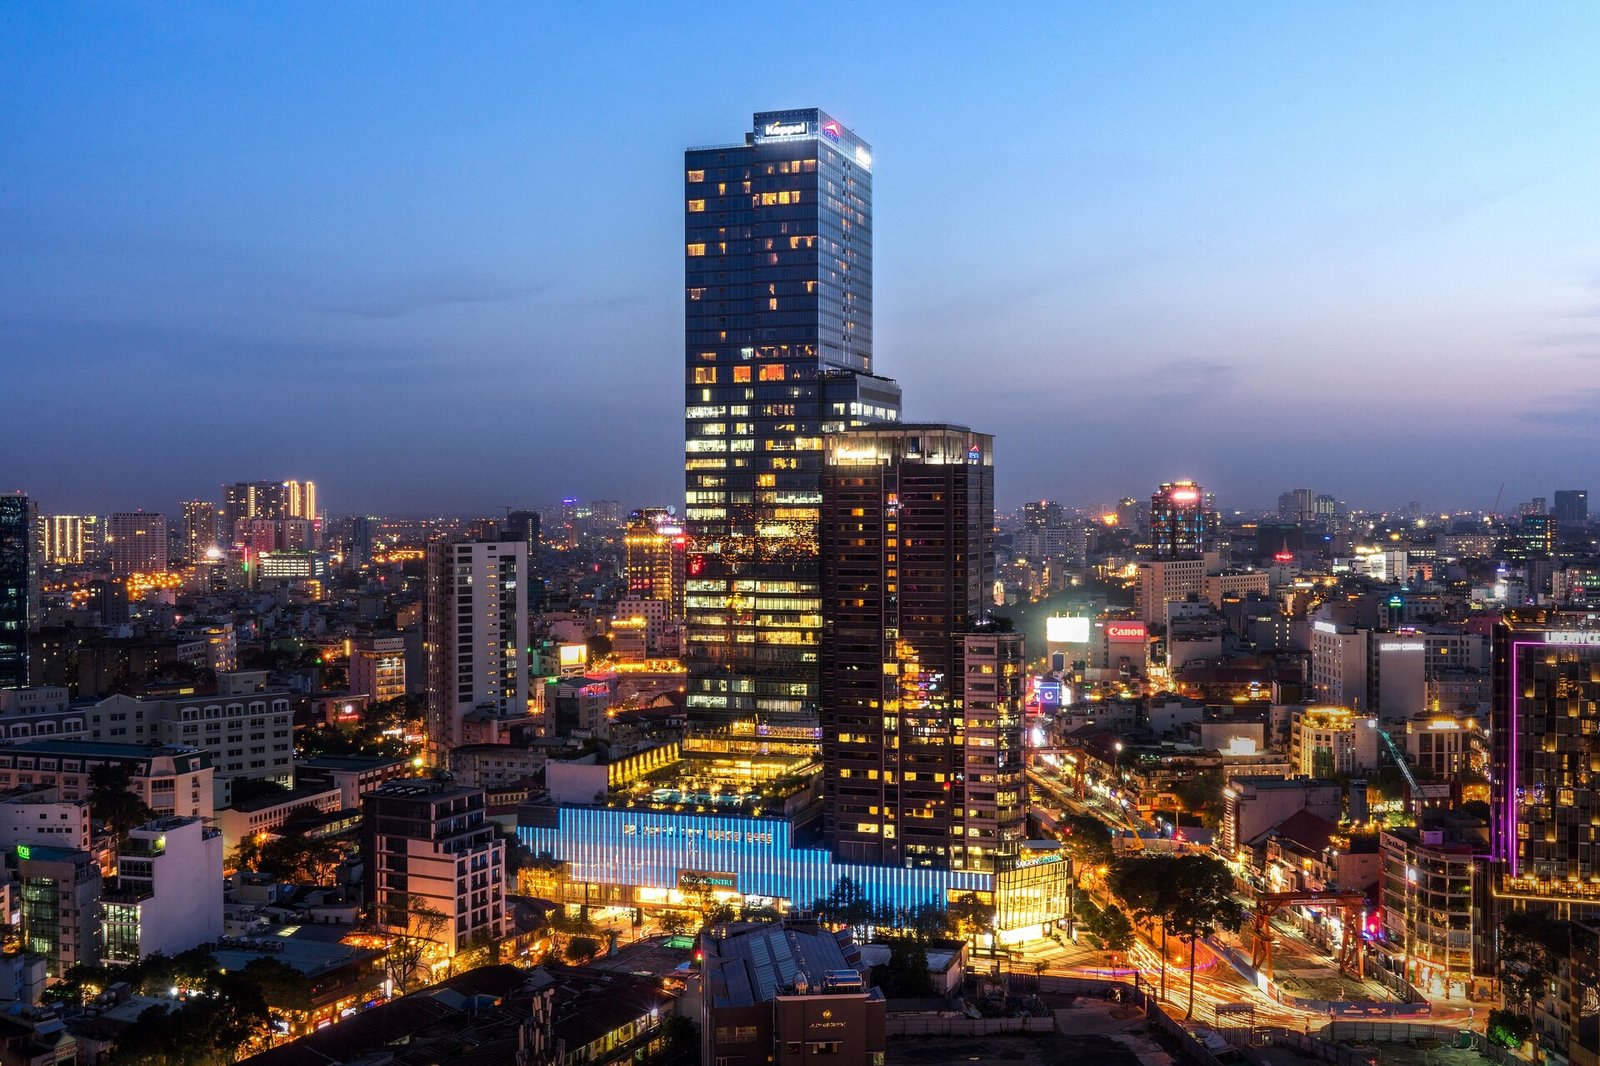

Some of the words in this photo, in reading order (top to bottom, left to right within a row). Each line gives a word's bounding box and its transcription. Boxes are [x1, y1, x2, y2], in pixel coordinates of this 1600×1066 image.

[765, 122, 806, 136] Keppel
[1109, 627, 1144, 636] Canon
[1545, 631, 1587, 643] LIBERTY
